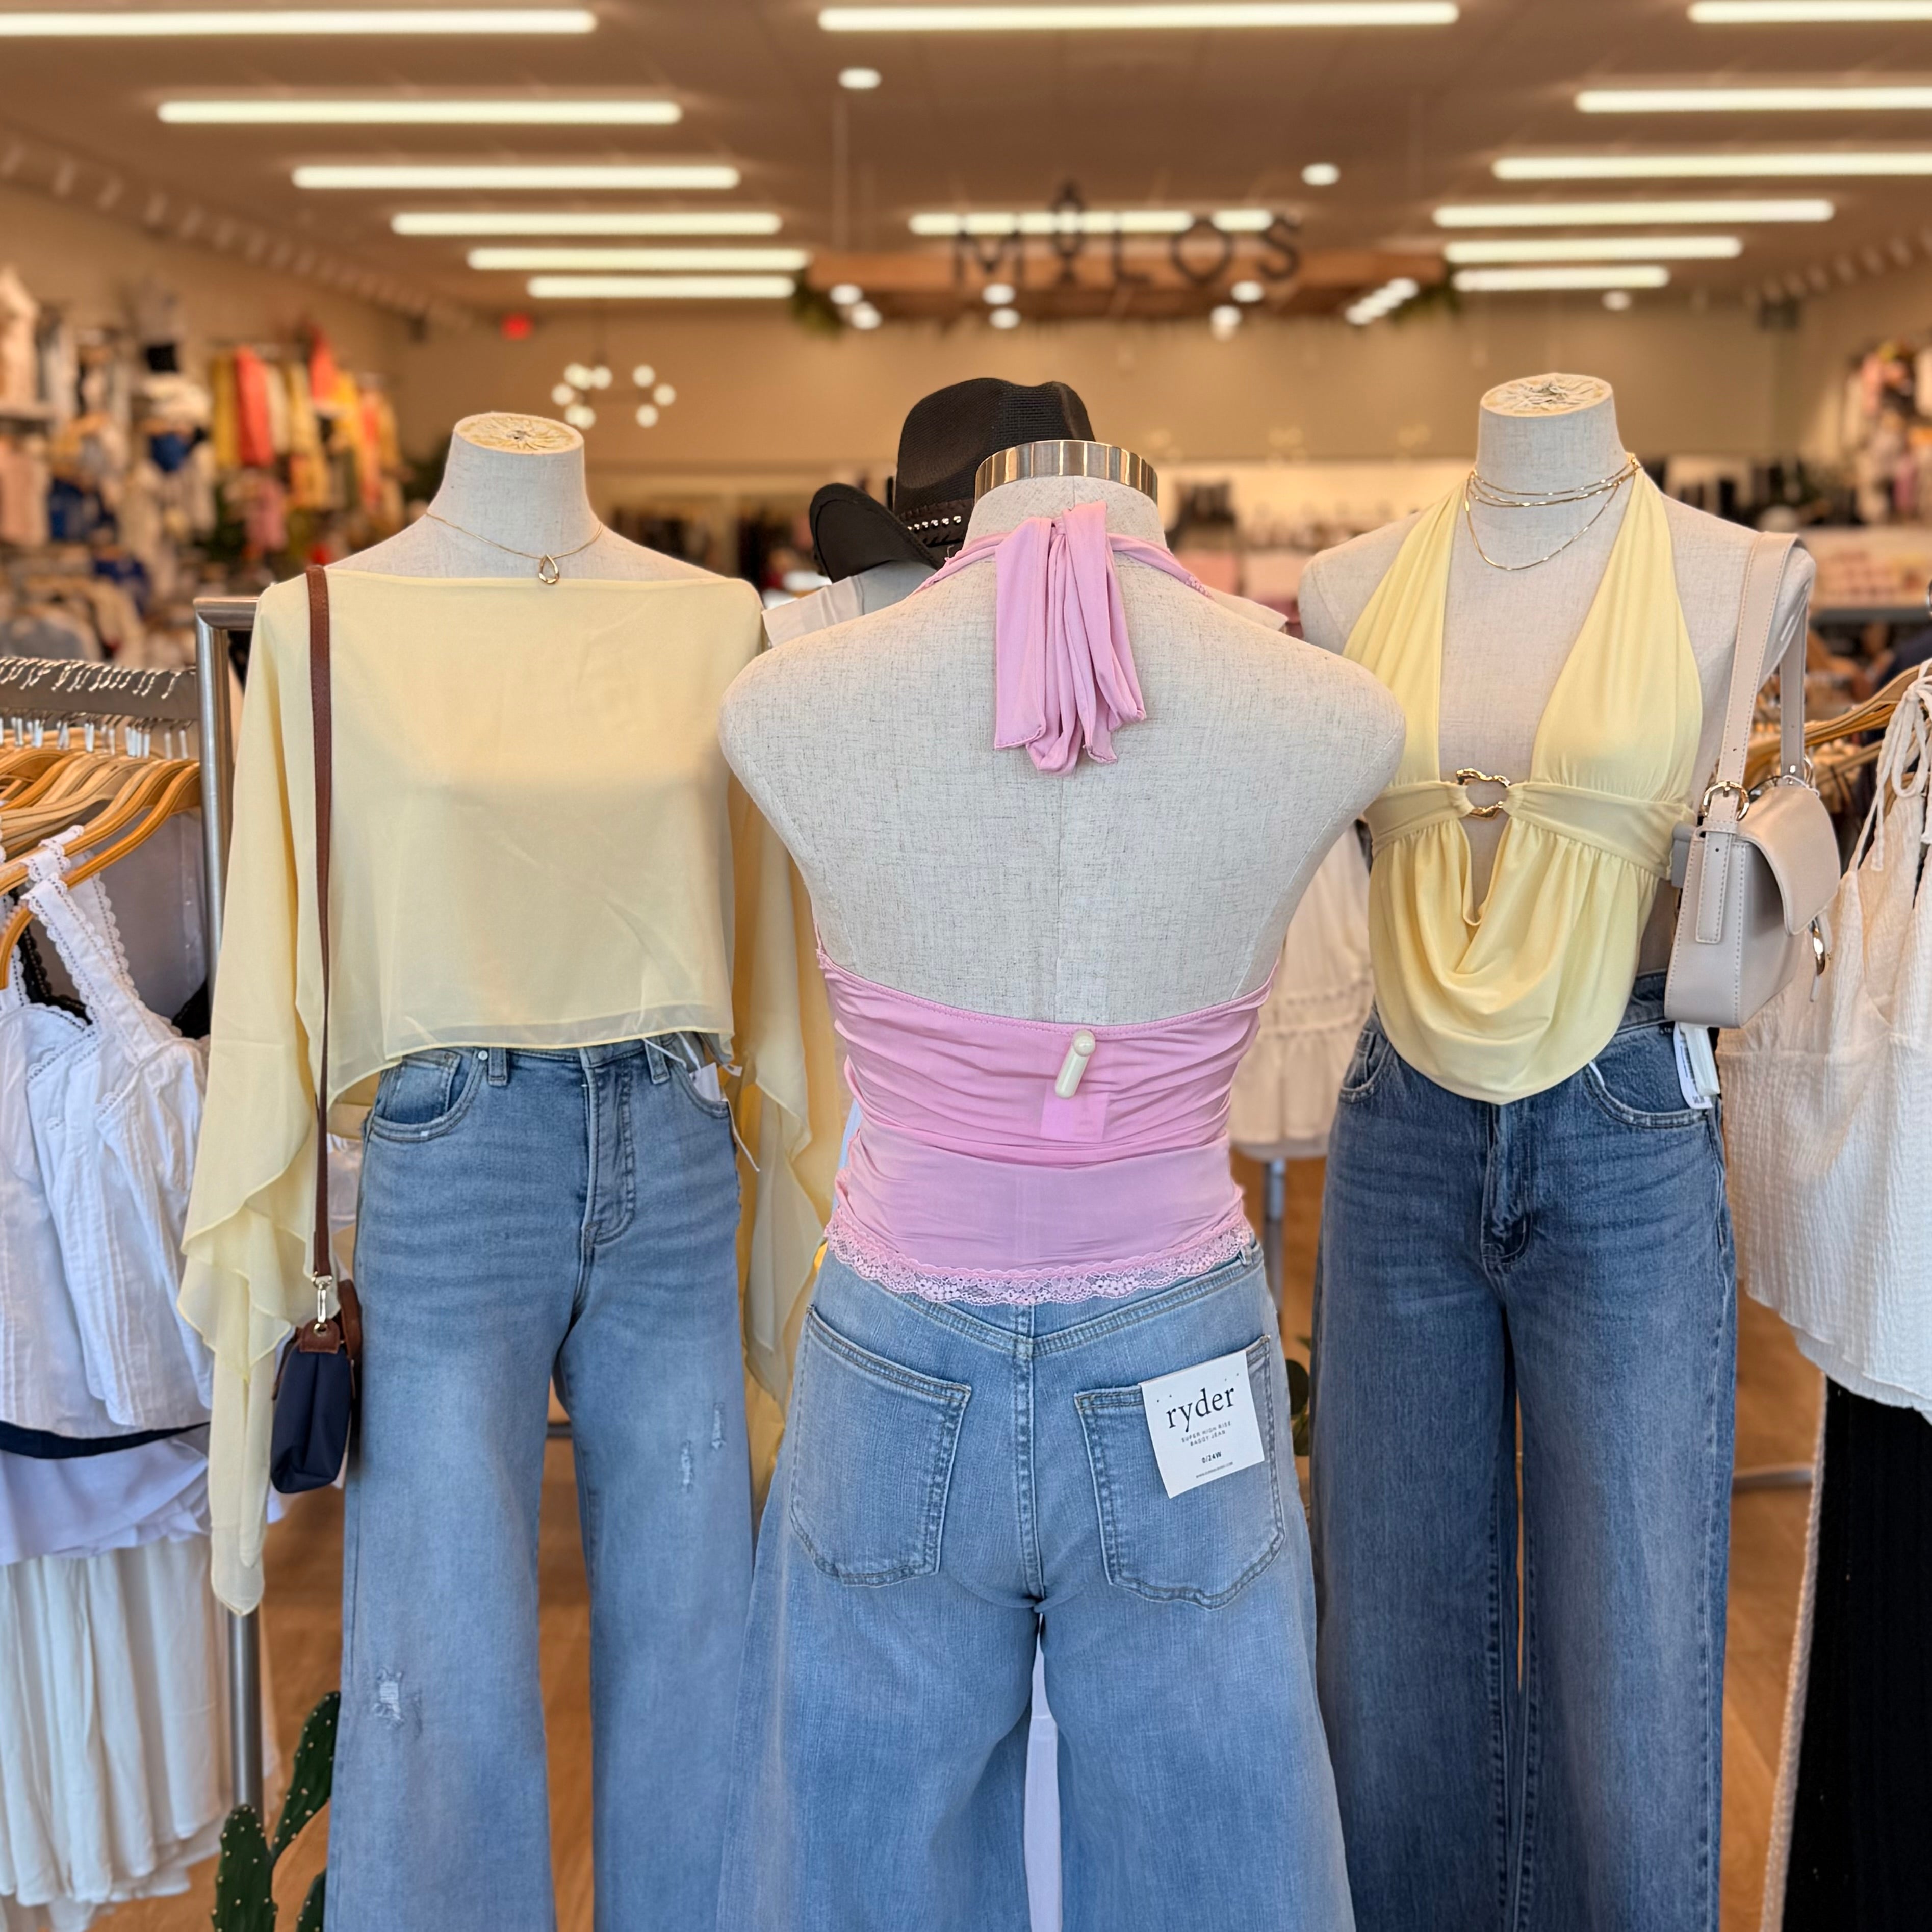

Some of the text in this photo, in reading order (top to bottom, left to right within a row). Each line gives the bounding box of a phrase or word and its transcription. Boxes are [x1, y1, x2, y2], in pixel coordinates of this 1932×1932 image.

[1166, 1388, 1234, 1432] ryder
[1181, 1432, 1200, 1442] SUPER
[1218, 1421, 1231, 1429] RISE
[1190, 1430, 1225, 1446] BAGGY JEAN
